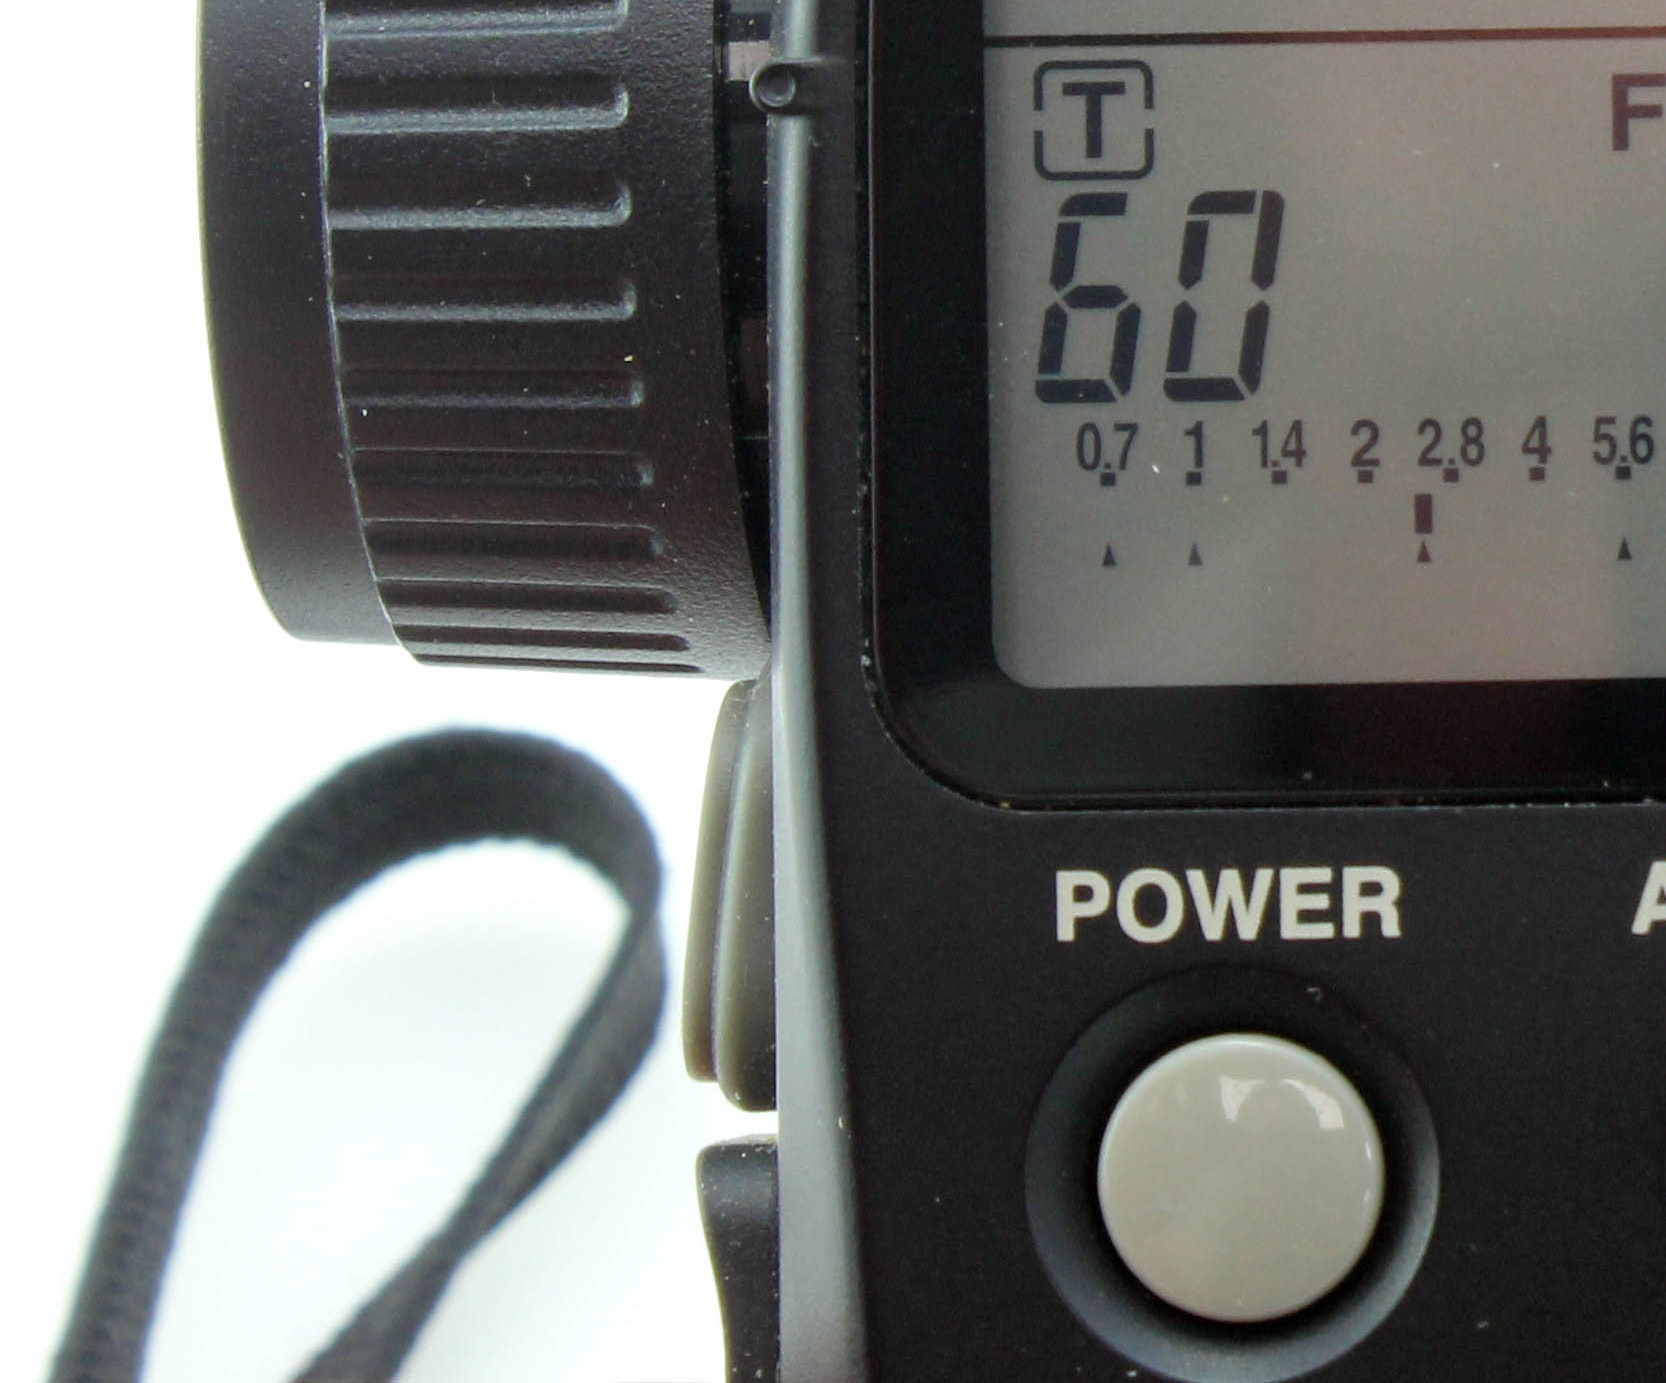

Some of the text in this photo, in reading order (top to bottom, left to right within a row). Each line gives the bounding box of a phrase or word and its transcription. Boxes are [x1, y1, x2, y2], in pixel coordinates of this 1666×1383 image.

[1061, 81, 1126, 159] T
[1034, 188, 1286, 404] 60
[1075, 422, 1140, 472] 0.7
[1183, 420, 1204, 470] 1
[1251, 420, 1307, 469] 1.4
[1350, 419, 1381, 468] 2
[1417, 417, 1486, 467] 2.8
[1521, 415, 1552, 465] 4
[1592, 414, 1655, 466] 5.6
[1056, 865, 1402, 944] POWER
